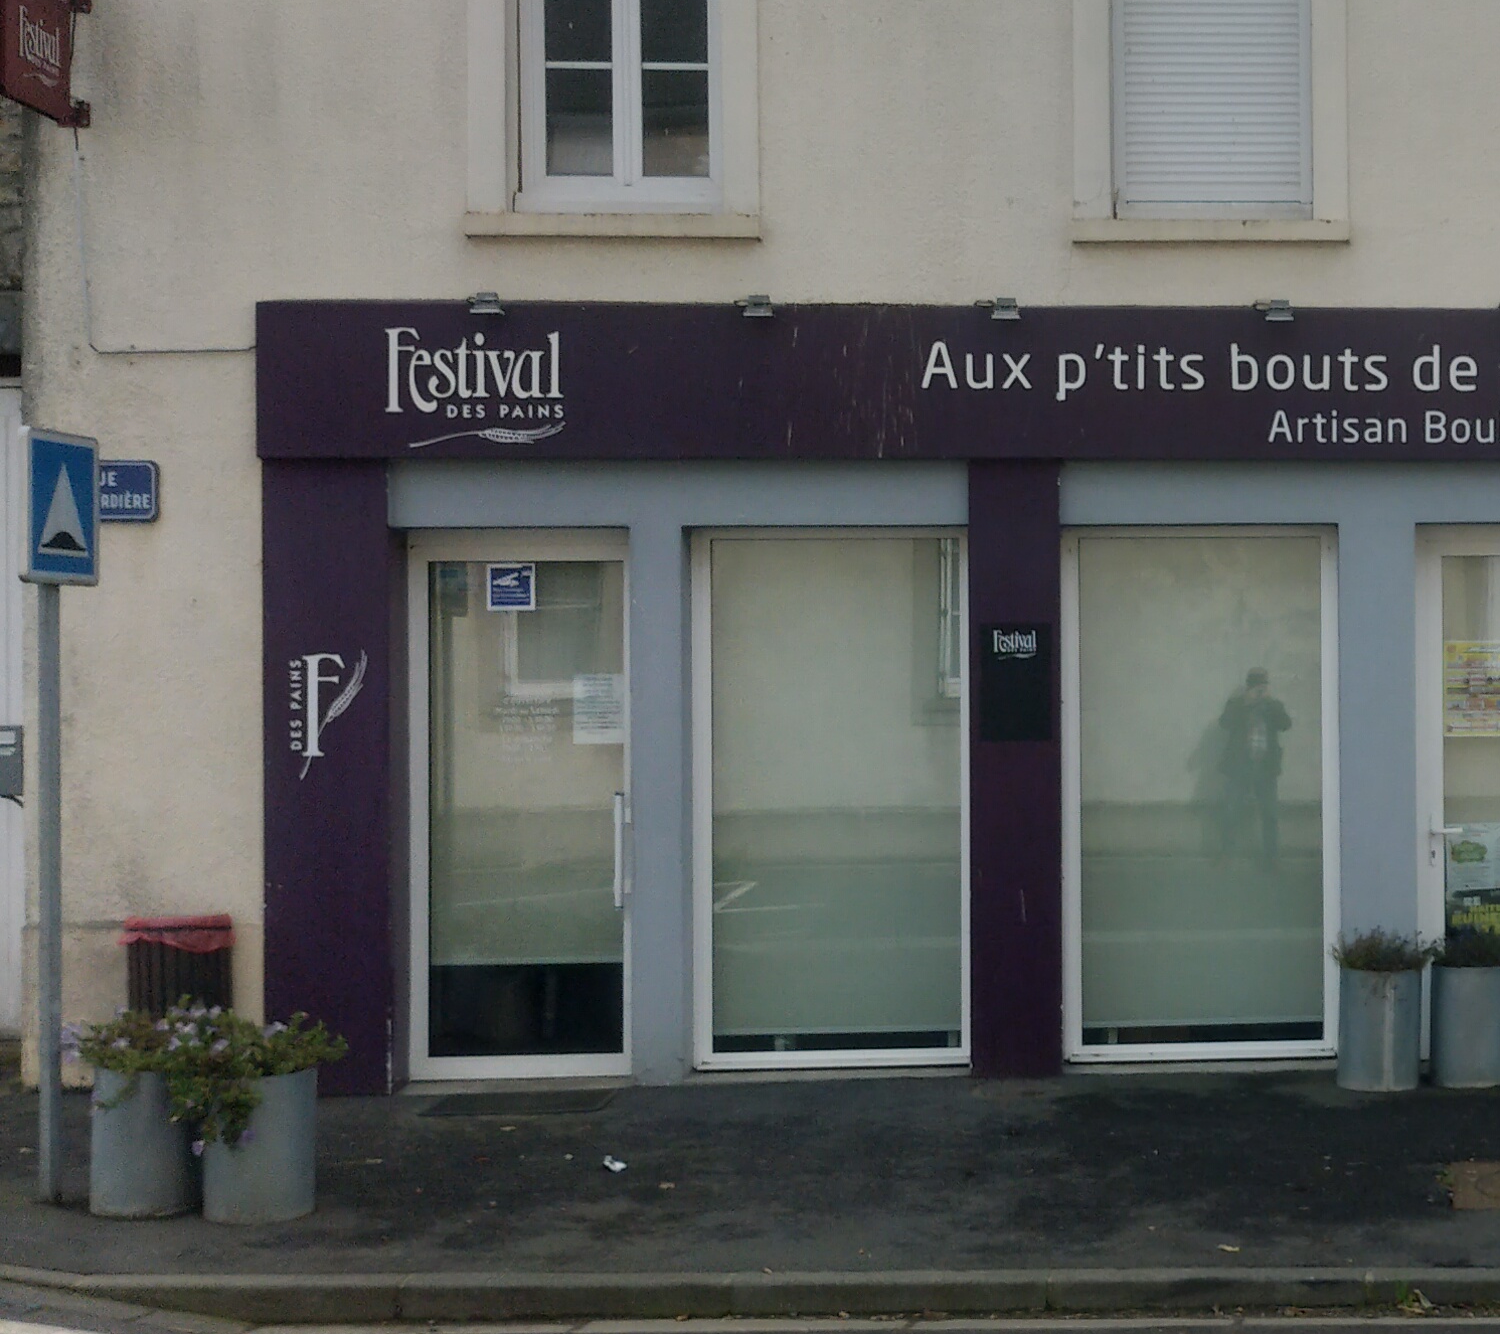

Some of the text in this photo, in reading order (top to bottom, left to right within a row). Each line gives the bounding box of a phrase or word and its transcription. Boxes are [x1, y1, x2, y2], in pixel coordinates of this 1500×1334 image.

[19, 4, 61, 68] Festival
[384, 326, 565, 413] Festival
[920, 340, 1033, 390] Aux
[1055, 342, 1206, 402] p'tits
[1229, 342, 1390, 392] bouts
[1411, 343, 1479, 392] de
[446, 403, 565, 419] DES PAINS
[1267, 409, 1409, 444] Artisan
[992, 629, 1038, 654] Festival
[288, 659, 304, 752] DES PAINS
